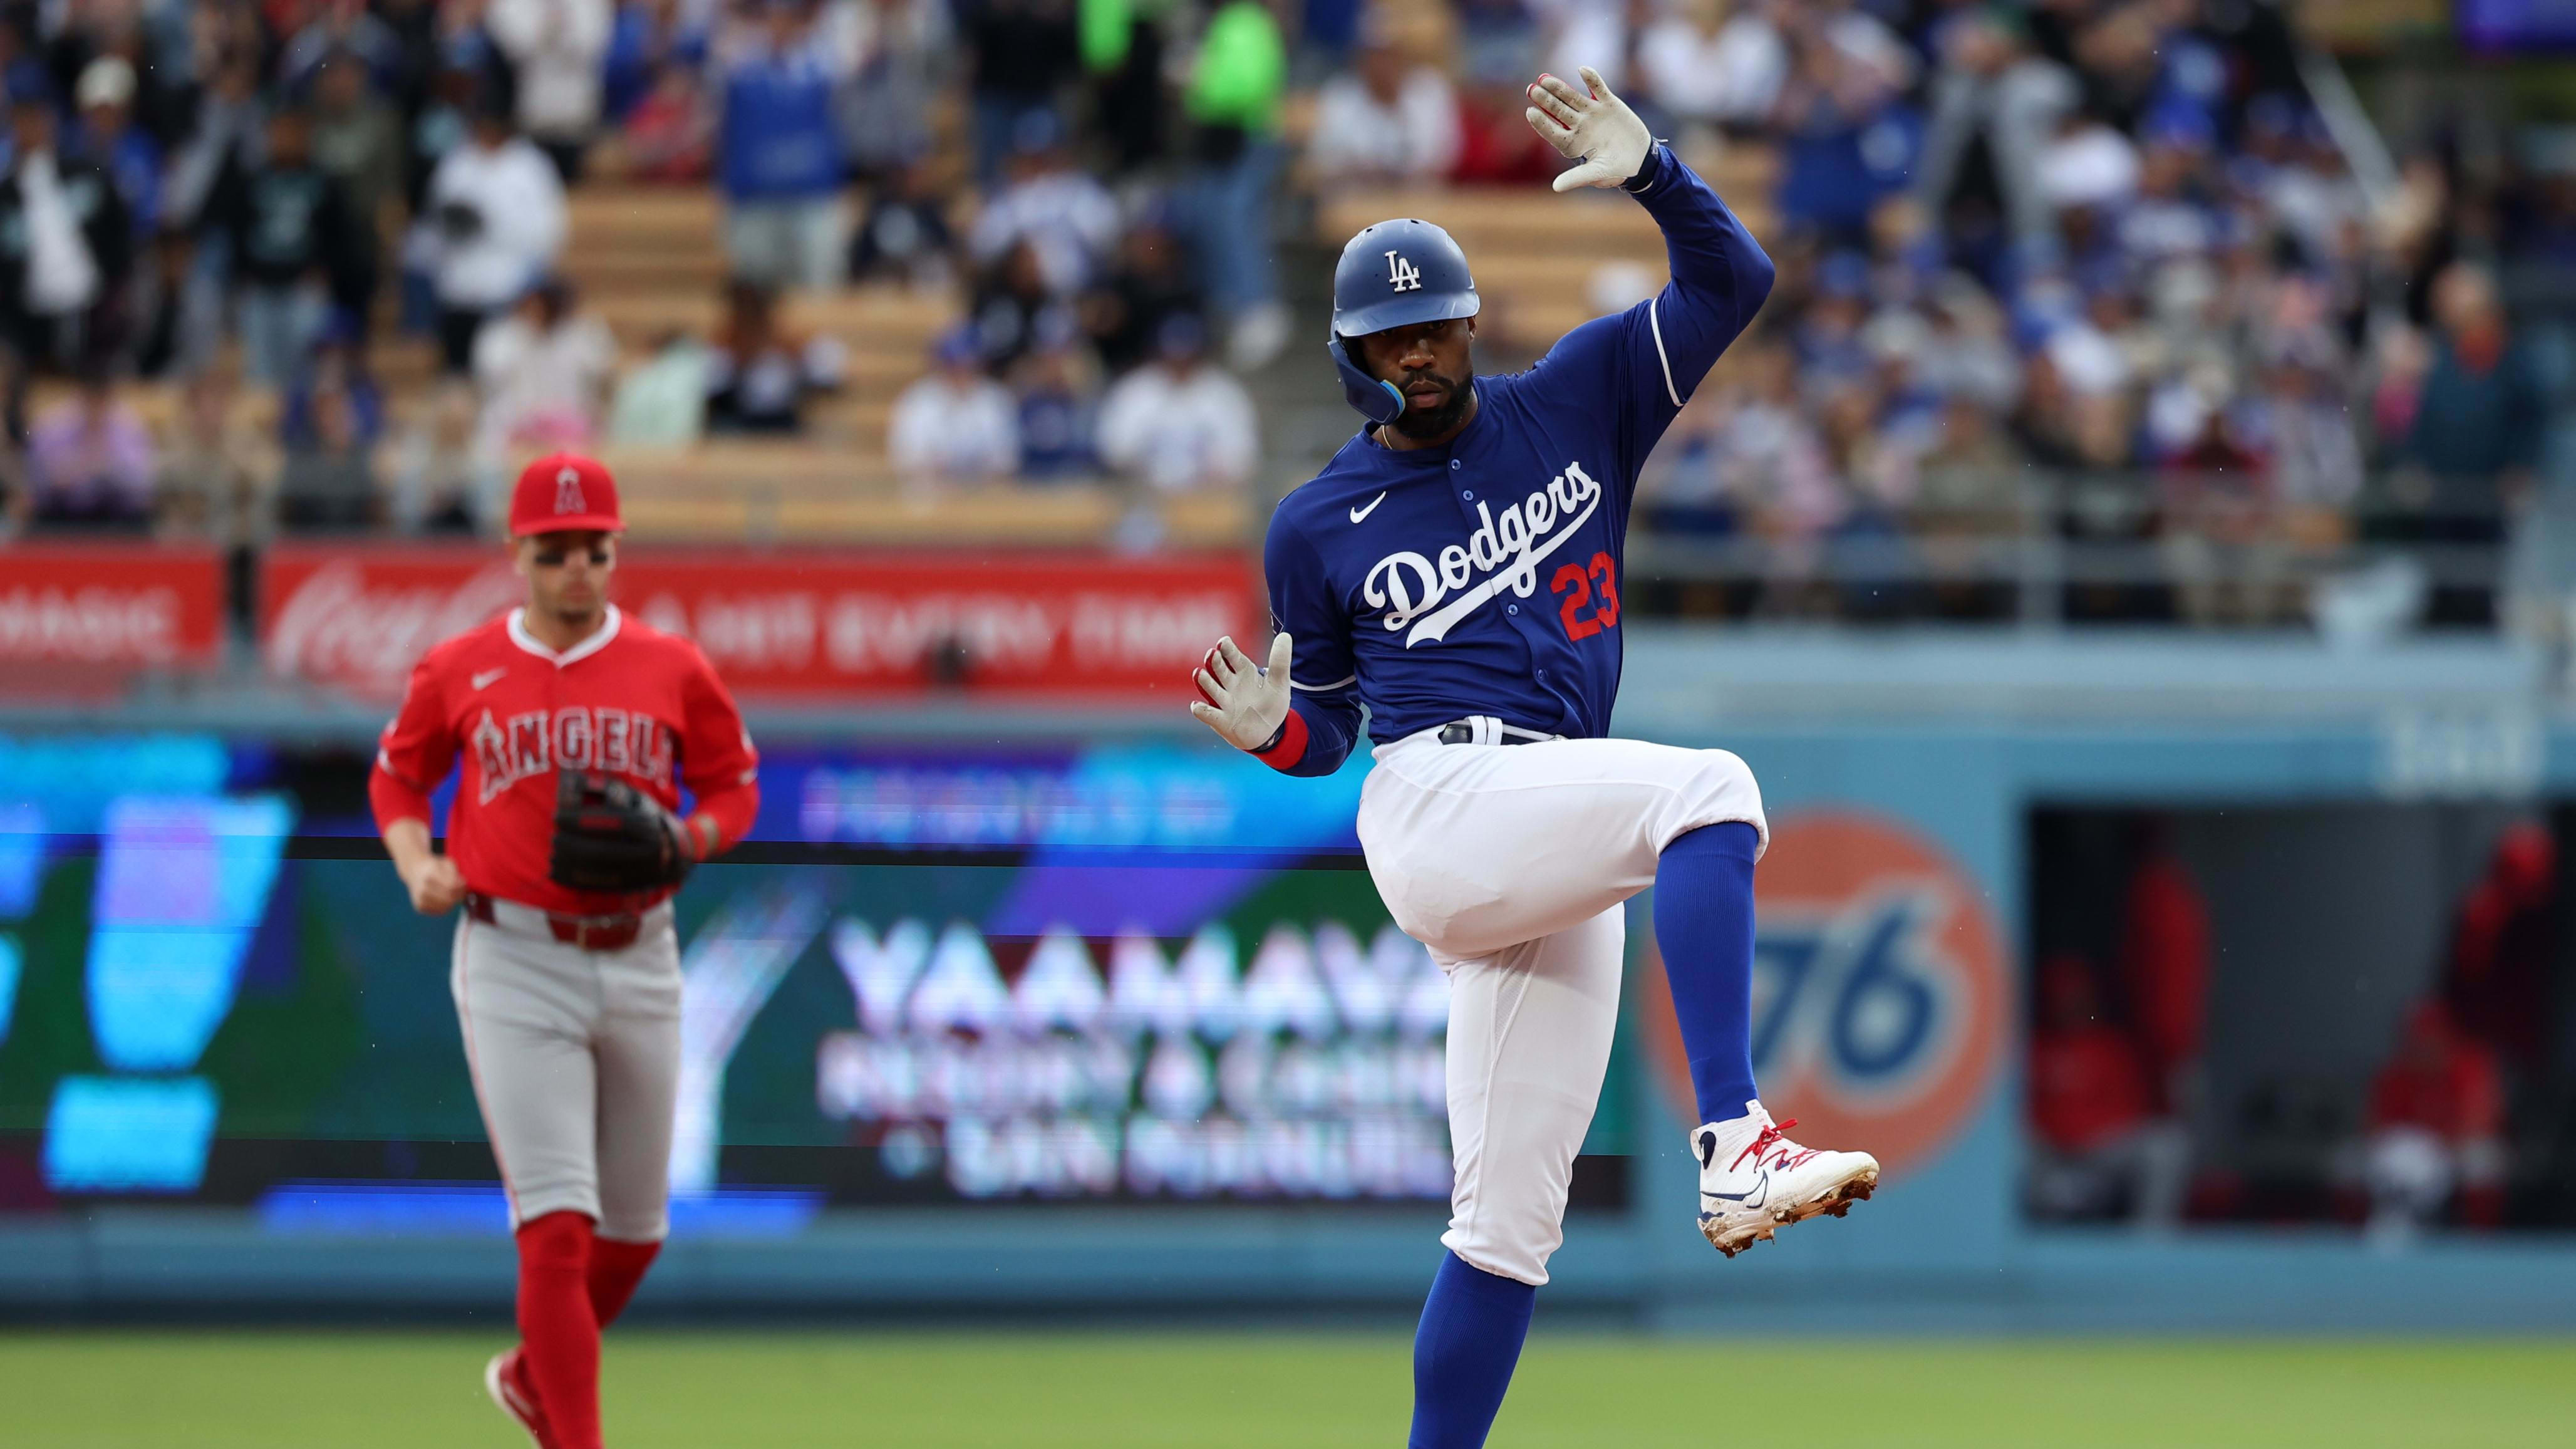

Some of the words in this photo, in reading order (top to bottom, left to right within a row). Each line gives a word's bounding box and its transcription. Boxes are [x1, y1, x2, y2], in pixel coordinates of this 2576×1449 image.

[1385, 250, 1421, 293] LA
[1363, 461, 1601, 648] Dodgers
[1550, 551, 1620, 642] 23
[1752, 902, 1937, 1079] 76
